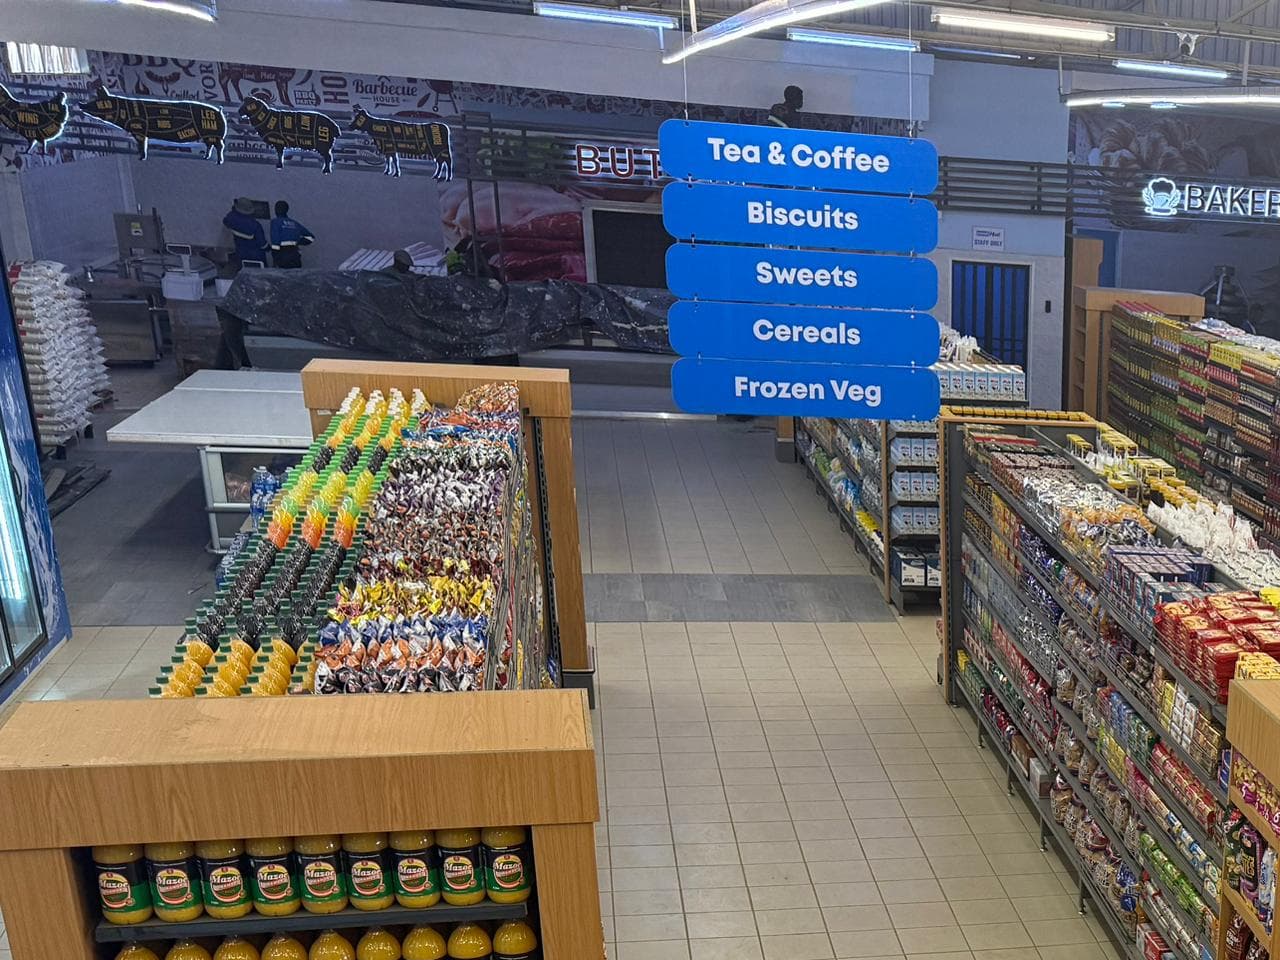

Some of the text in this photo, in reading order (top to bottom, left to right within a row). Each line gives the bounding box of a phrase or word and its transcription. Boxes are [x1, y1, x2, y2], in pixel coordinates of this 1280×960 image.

[352, 80, 418, 97] Barbecue
[373, 95, 401, 104] HOUSE
[17, 111, 39, 126] WING
[201, 109, 216, 120] LEG
[201, 119, 218, 131] HAM
[318, 125, 330, 143] LEG
[708, 137, 890, 173] Tea & Coffee
[748, 200, 859, 230] Biscuits
[756, 262, 858, 288] Sweets
[753, 319, 861, 346] Cereals
[735, 376, 881, 408] Frozen Veg
[398, 866, 428, 875] Mazoe
[444, 863, 472, 873] Mazoe
[493, 861, 521, 870] Mazoe
[258, 873, 288, 882] Mazoe
[304, 868, 335, 878] Mazoe
[352, 868, 381, 877] Mazoe
[100, 880, 128, 889] Mazoe
[157, 875, 187, 885] Mazoe
[211, 875, 241, 884] Mazoe
